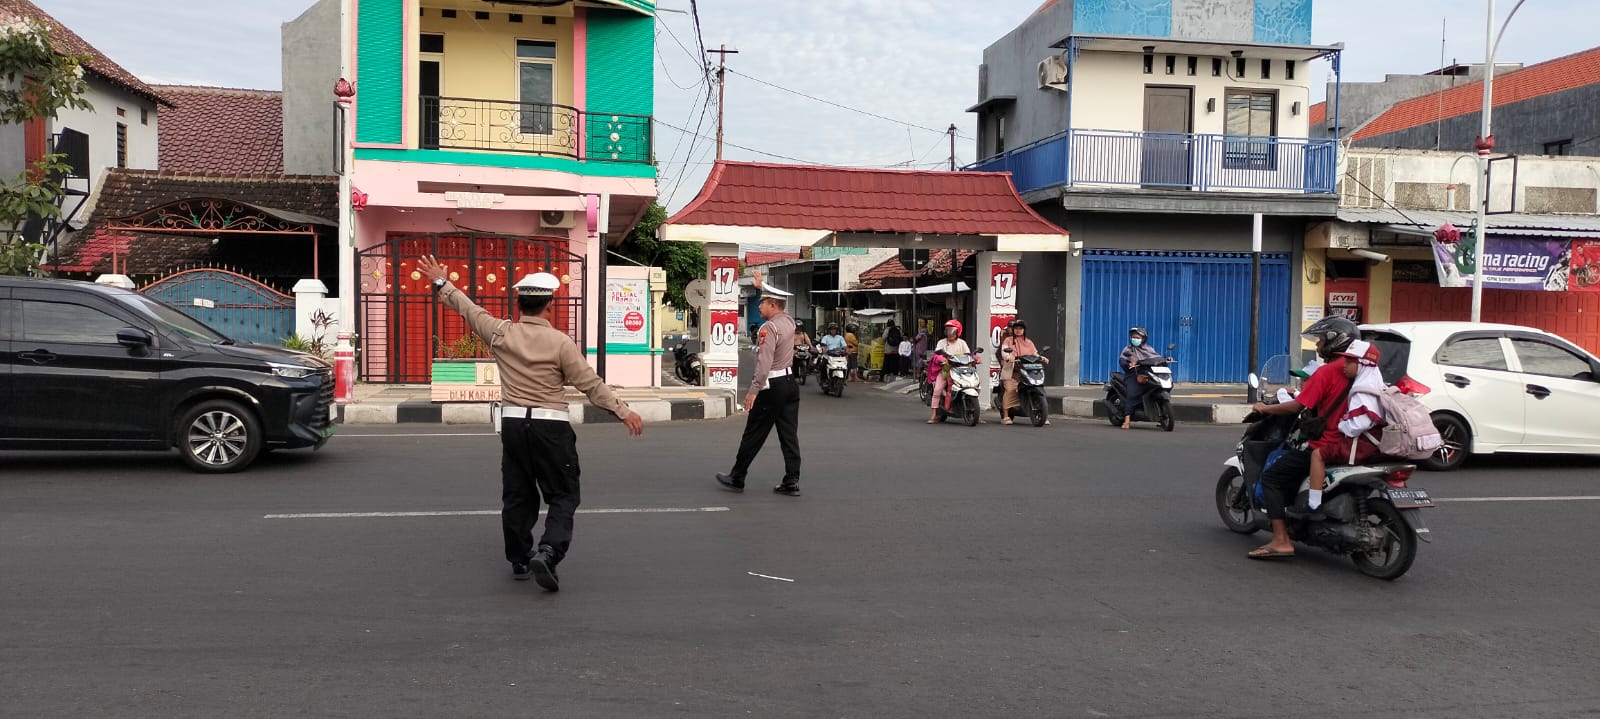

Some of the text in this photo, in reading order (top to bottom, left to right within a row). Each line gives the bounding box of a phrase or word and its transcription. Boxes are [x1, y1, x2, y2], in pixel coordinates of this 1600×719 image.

[1483, 252, 1549, 270] ma racing
[713, 267, 735, 294] 17
[993, 273, 1013, 299] 17
[712, 322, 736, 346] 08
[991, 326, 1002, 348] 0
[712, 371, 733, 382] 1945
